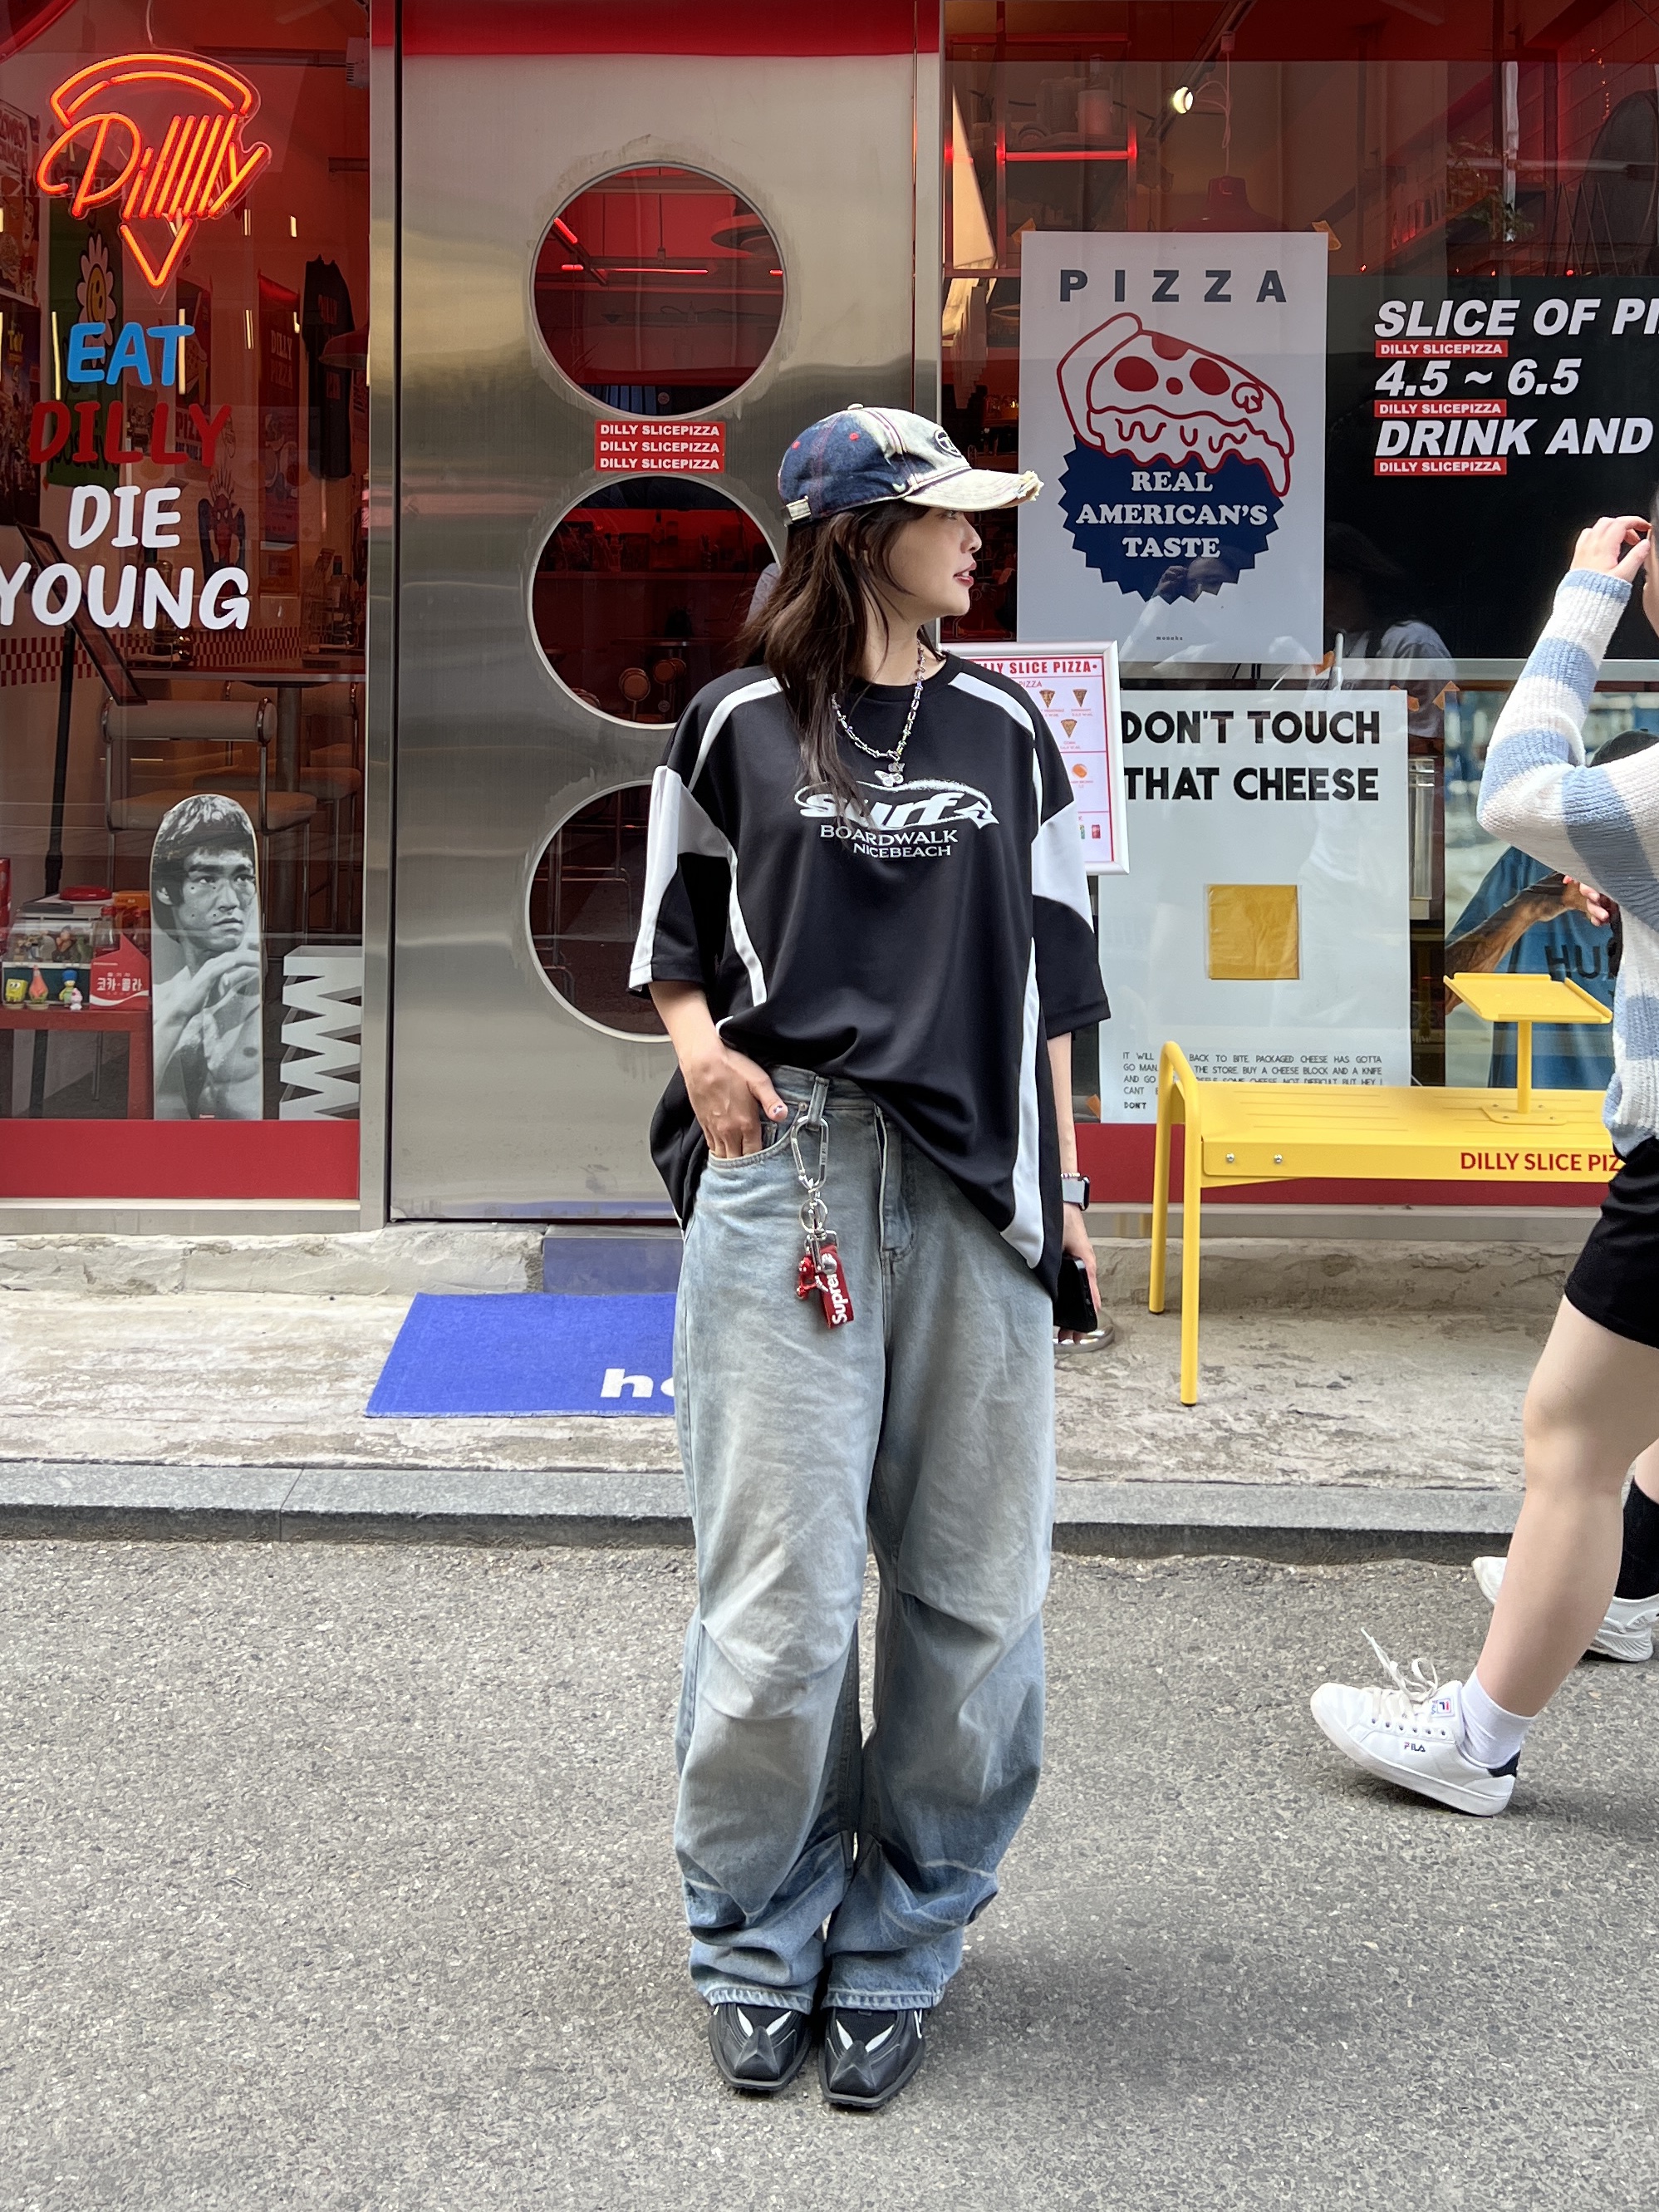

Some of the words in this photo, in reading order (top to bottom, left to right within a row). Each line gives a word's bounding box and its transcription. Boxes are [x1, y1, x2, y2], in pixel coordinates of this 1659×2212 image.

[1059, 269, 1287, 302] PIZZA
[1374, 299, 1521, 337] SLICE
[1533, 298, 1602, 337] OF
[1611, 297, 1659, 336] PI
[66, 322, 195, 386] EAT
[1381, 343, 1418, 354] DILLY
[1422, 343, 1503, 355] SLICEPIZZA
[1374, 359, 1451, 396] 4.5
[1464, 371, 1494, 385] ~
[1507, 358, 1583, 396] 6.5
[1379, 403, 1417, 414] DILLY
[1421, 403, 1502, 414] SLICEPIZZA
[29, 401, 233, 467] DILLY
[600, 424, 639, 435] DILLY
[641, 425, 720, 436] SLICEPIZZA
[1374, 419, 1539, 457] DRINK
[1544, 417, 1654, 455] AND
[600, 441, 639, 452] DILLY
[641, 442, 720, 453] SLICEPIZZA
[600, 458, 638, 469] DILLY
[641, 458, 720, 469] SLICEPIZZA
[1379, 461, 1417, 472] DILLY
[1421, 461, 1502, 472] SLICEPIZZA
[1131, 470, 1214, 493] REAL
[68, 484, 182, 549] DIE
[1076, 504, 1268, 526] AMERICAN'S
[1122, 537, 1221, 558] TASTE
[1009, 661, 1048, 674] SLICE
[1053, 661, 1092, 673] PIZZA
[1121, 710, 1234, 744] DON'T
[1247, 710, 1380, 745] TOUCH
[1124, 767, 1220, 800] THAT
[1233, 767, 1379, 801] CHEESE
[820, 824, 959, 847] BOARDWALK
[852, 842, 951, 858] NICEBEACH
[1544, 944, 1617, 982] HU
[1136, 1052, 1155, 1061] WILL
[1189, 1054, 1210, 1063] BACK
[1215, 1054, 1228, 1063] TO
[1255, 1054, 1294, 1064] PACKAGED
[1300, 1054, 1328, 1064] CHEESE
[1334, 1054, 1350, 1064] HAS
[1355, 1054, 1382, 1064] GOTTA
[1123, 1064, 1136, 1072] GO
[1194, 1065, 1208, 1074] THE
[1212, 1065, 1237, 1074] STORE
[1243, 1066, 1258, 1075] BUY
[1261, 1066, 1268, 1075] A
[1271, 1066, 1299, 1075] CHEESE
[1303, 1066, 1328, 1075] BLOCK
[1333, 1066, 1348, 1076] AND
[1352, 1067, 1359, 1076] A
[1123, 1074, 1140, 1084] AND
[1143, 1074, 1156, 1084] GO
[1460, 1152, 1519, 1170] DILLY
[1524, 1153, 1582, 1172] SLICE
[827, 1272, 849, 1325] Supre
